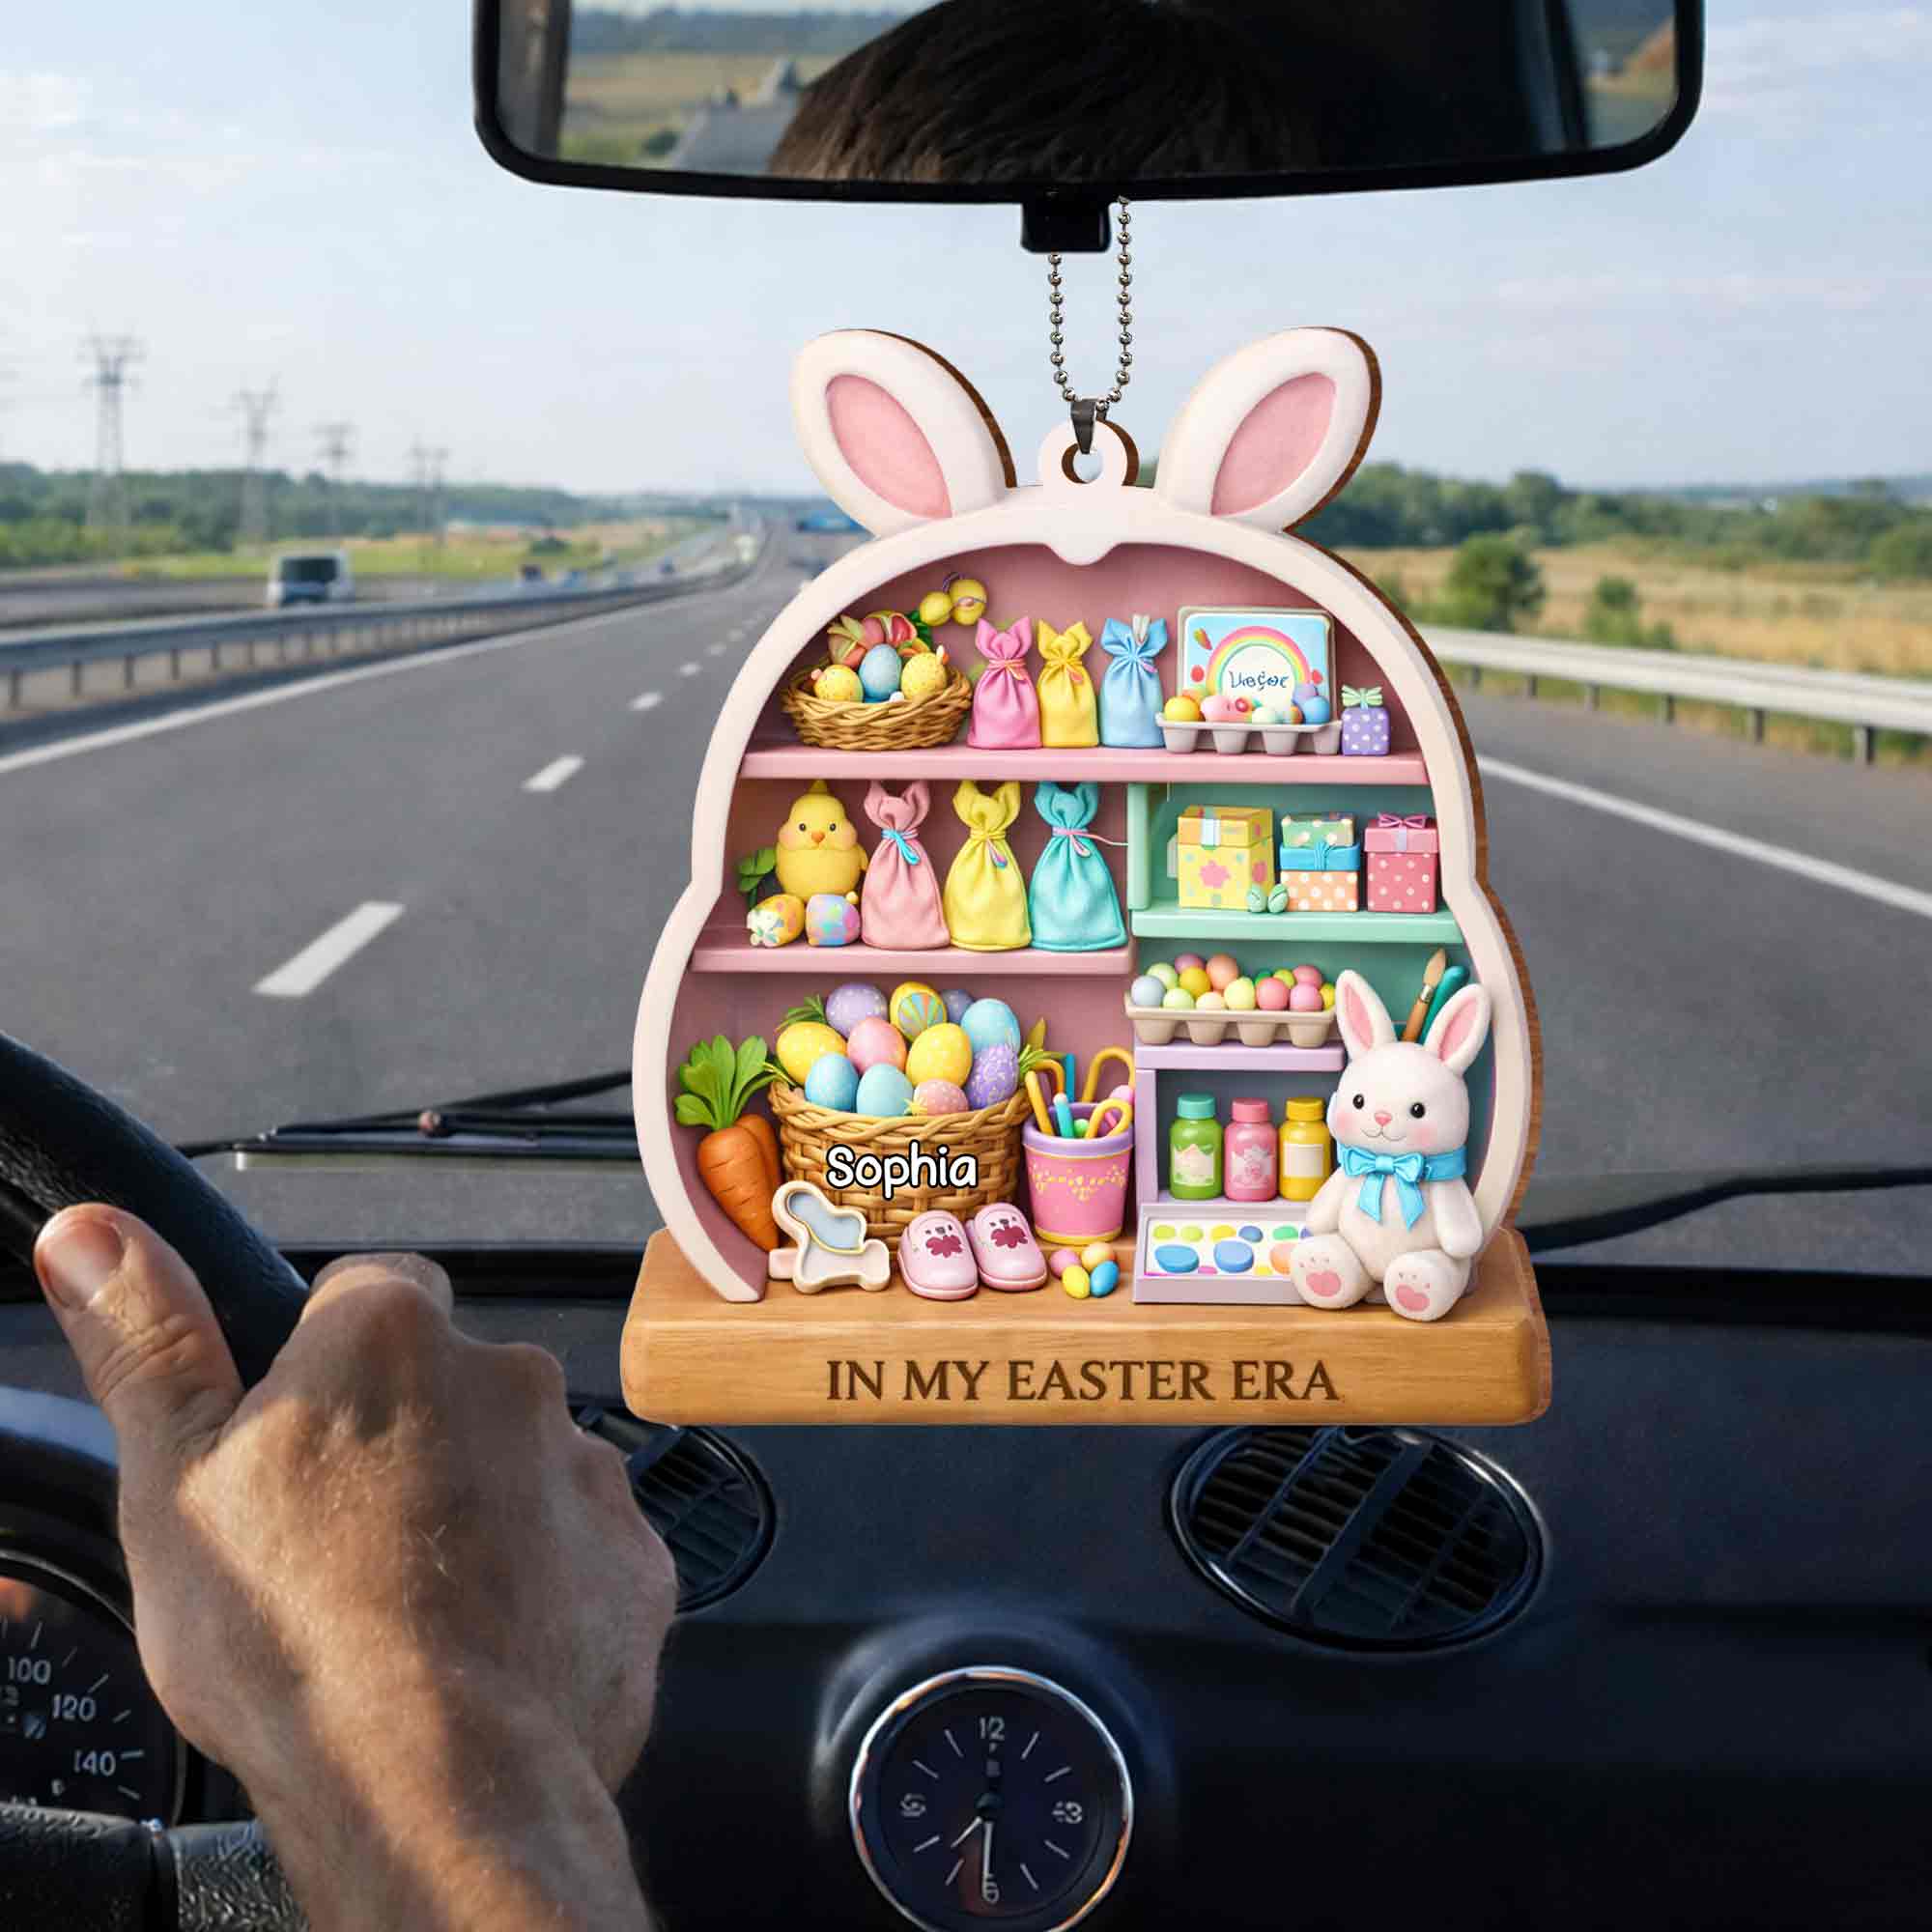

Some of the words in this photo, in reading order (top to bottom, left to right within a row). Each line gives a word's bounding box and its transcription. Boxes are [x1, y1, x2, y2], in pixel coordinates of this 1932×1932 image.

[826, 1140, 979, 1201] Sophia
[827, 1360, 885, 1400] IN
[903, 1360, 989, 1400] MY
[1007, 1360, 1216, 1400] EASTER
[1232, 1360, 1339, 1400] ERA
[8, 1656, 52, 1685] 100
[52, 1693, 96, 1721] 120
[979, 1717, 1006, 1741] 12
[73, 1749, 116, 1776] 140
